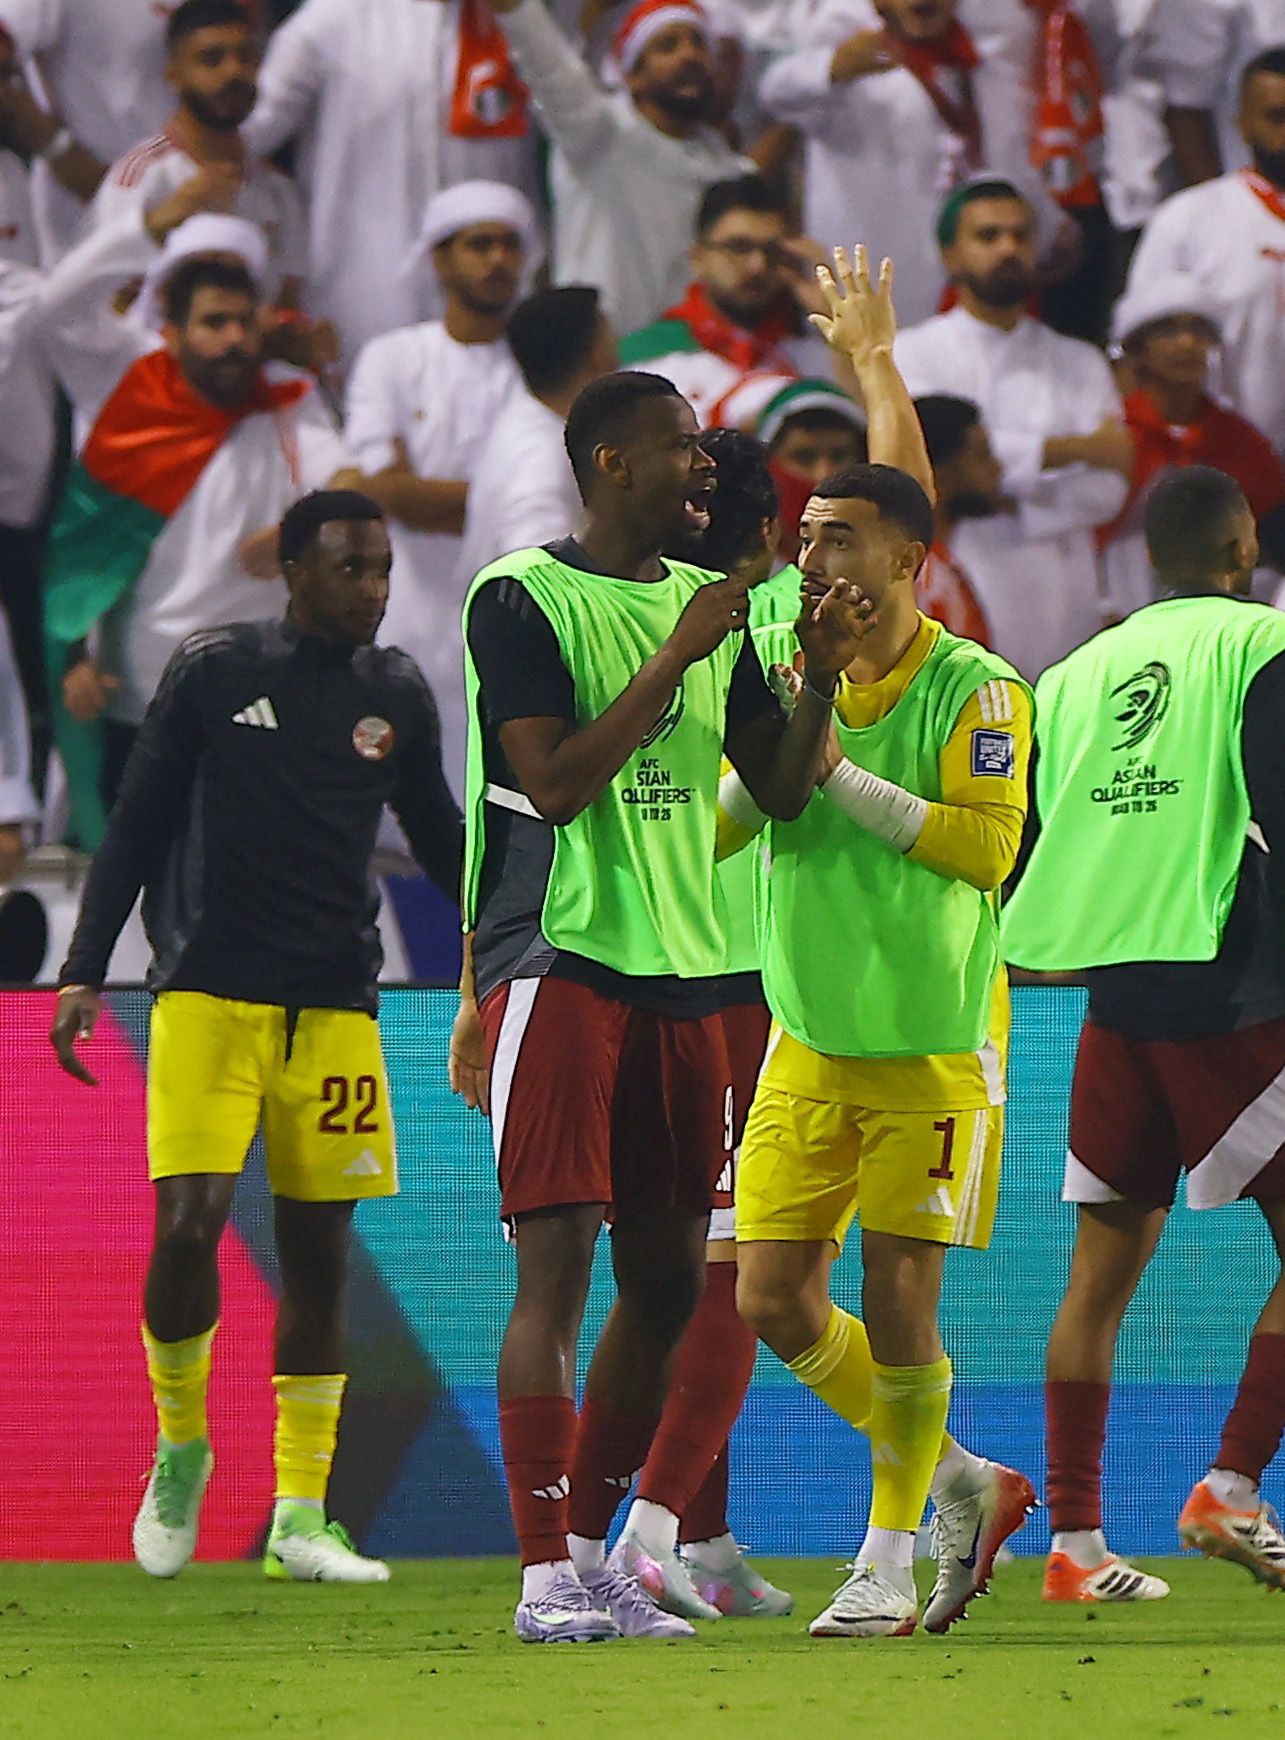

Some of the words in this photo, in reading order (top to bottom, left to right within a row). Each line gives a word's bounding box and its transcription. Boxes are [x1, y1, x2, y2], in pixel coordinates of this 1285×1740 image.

[1091, 779, 1180, 803] QUALIFIERS
[319, 1075, 379, 1134] 22
[927, 1116, 956, 1181] 1
